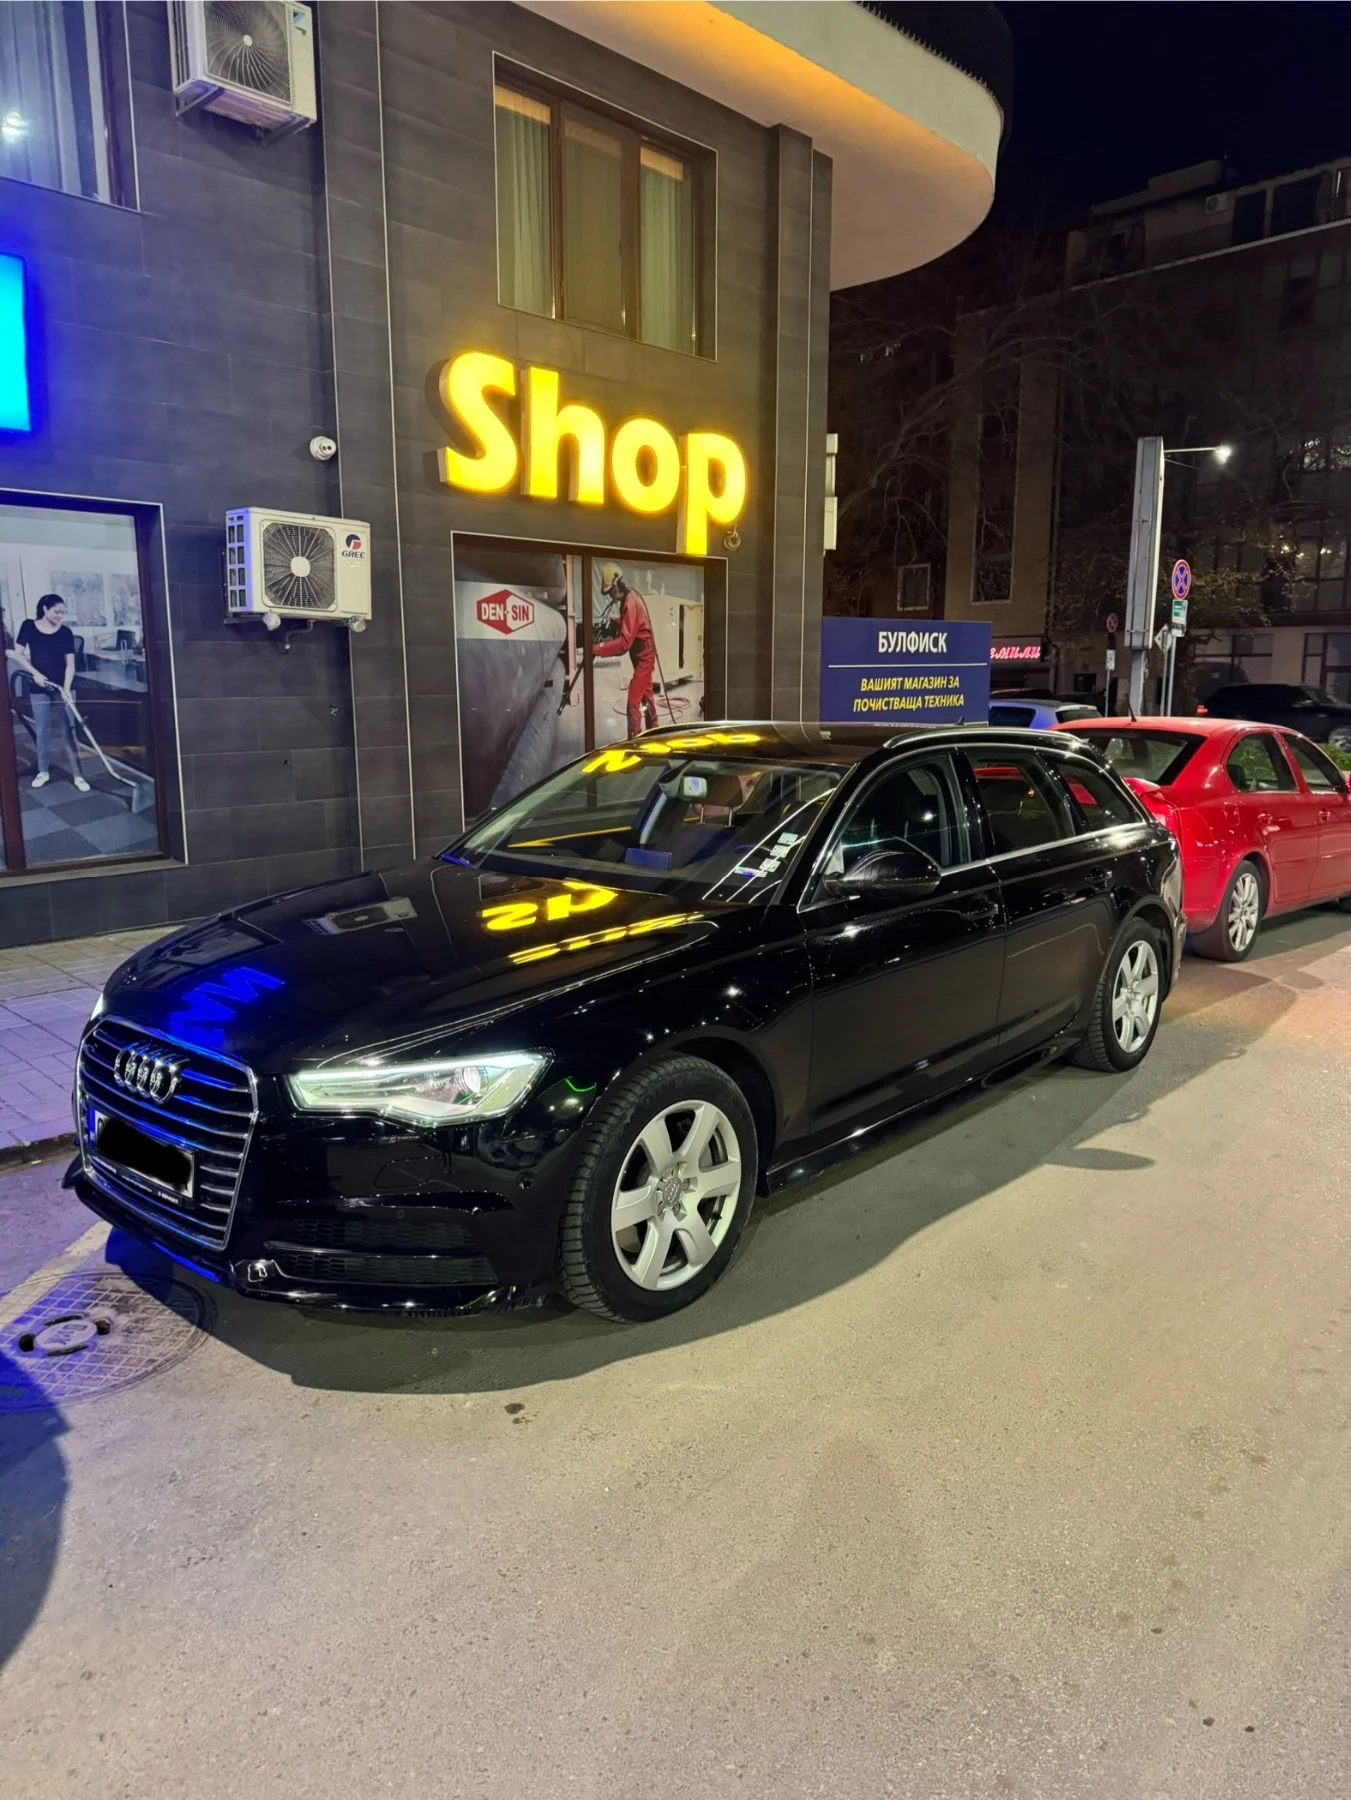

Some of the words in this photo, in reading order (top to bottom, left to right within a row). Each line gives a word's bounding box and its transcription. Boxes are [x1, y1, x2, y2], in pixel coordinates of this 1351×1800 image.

[440, 351, 746, 556] Shop
[341, 550, 366, 559] GREE
[878, 631, 948, 653] БУЛФИСК
[860, 677, 902, 692] ВАШИЯТ
[903, 677, 947, 690] МАГАЗИН
[948, 676, 960, 688] ЗА
[853, 697, 922, 712] ПОЧИСТВАЩА
[924, 694, 964, 707] ТЕХНИКА
